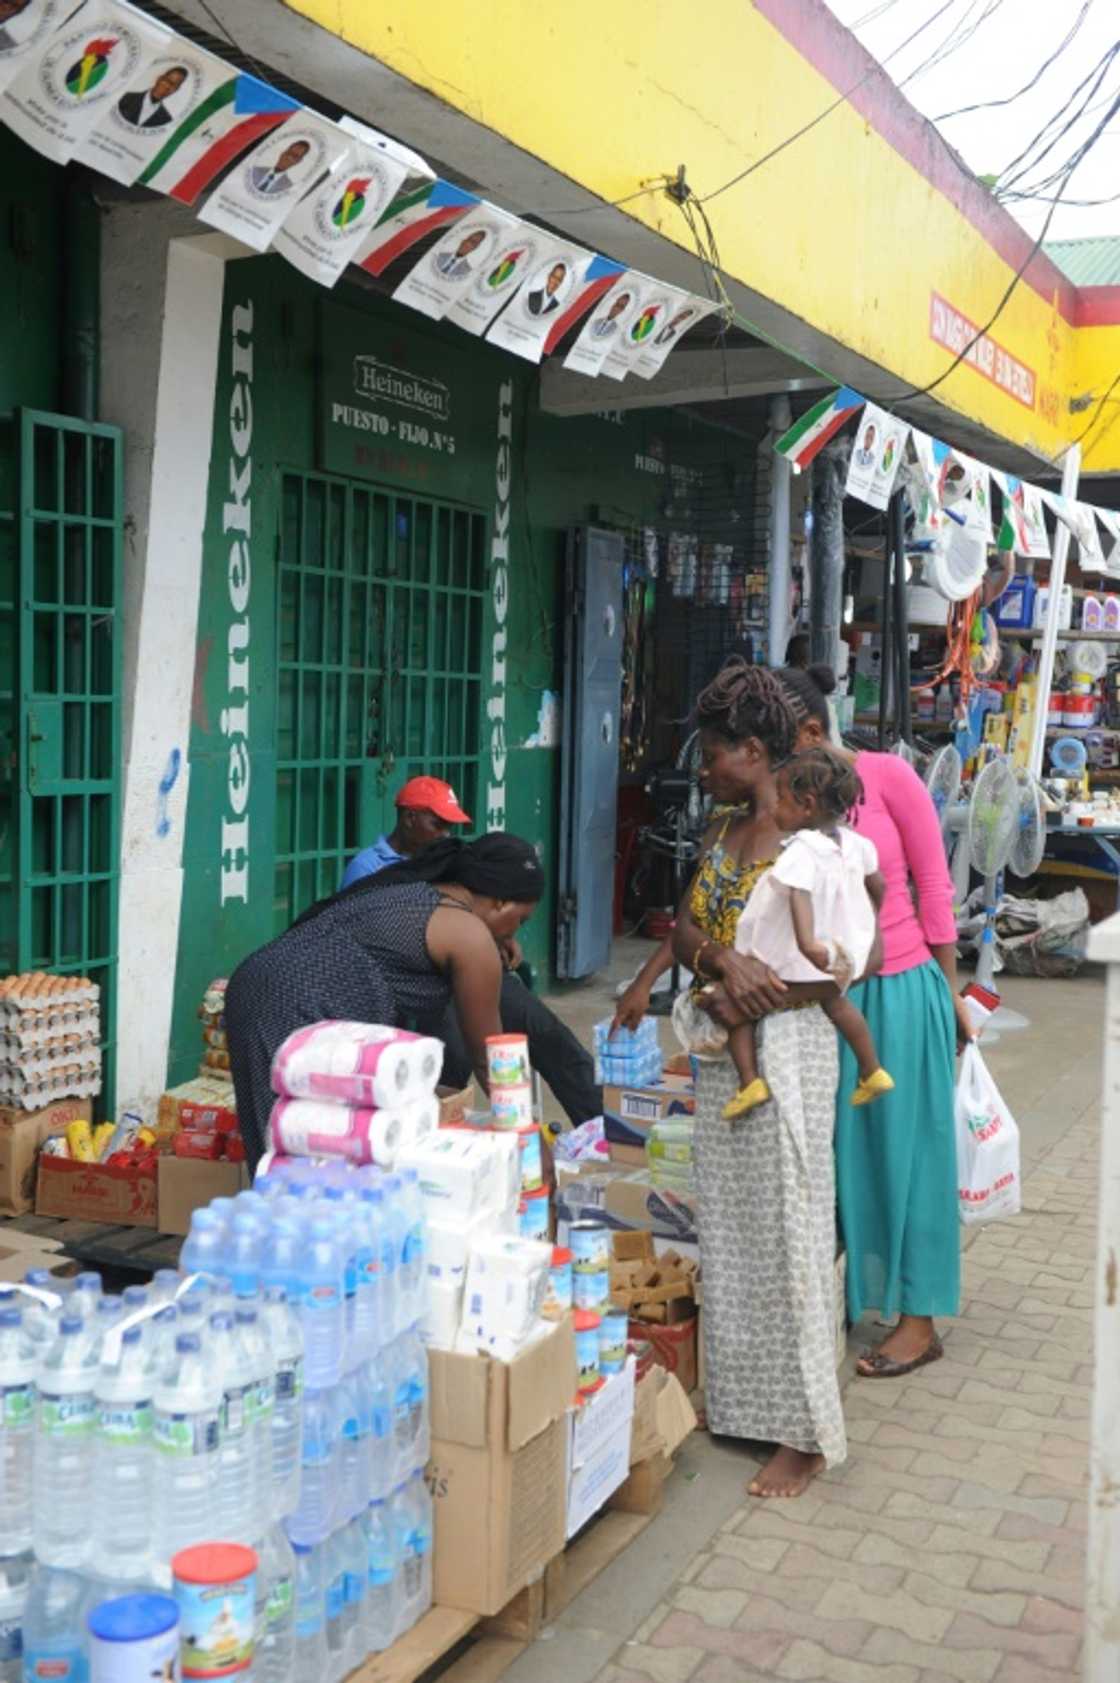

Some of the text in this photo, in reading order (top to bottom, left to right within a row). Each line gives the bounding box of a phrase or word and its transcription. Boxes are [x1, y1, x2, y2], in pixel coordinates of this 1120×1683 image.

[362, 366, 443, 410] Heineken
[332, 402, 389, 435] PUESTO
[221, 298, 254, 907] Heineken
